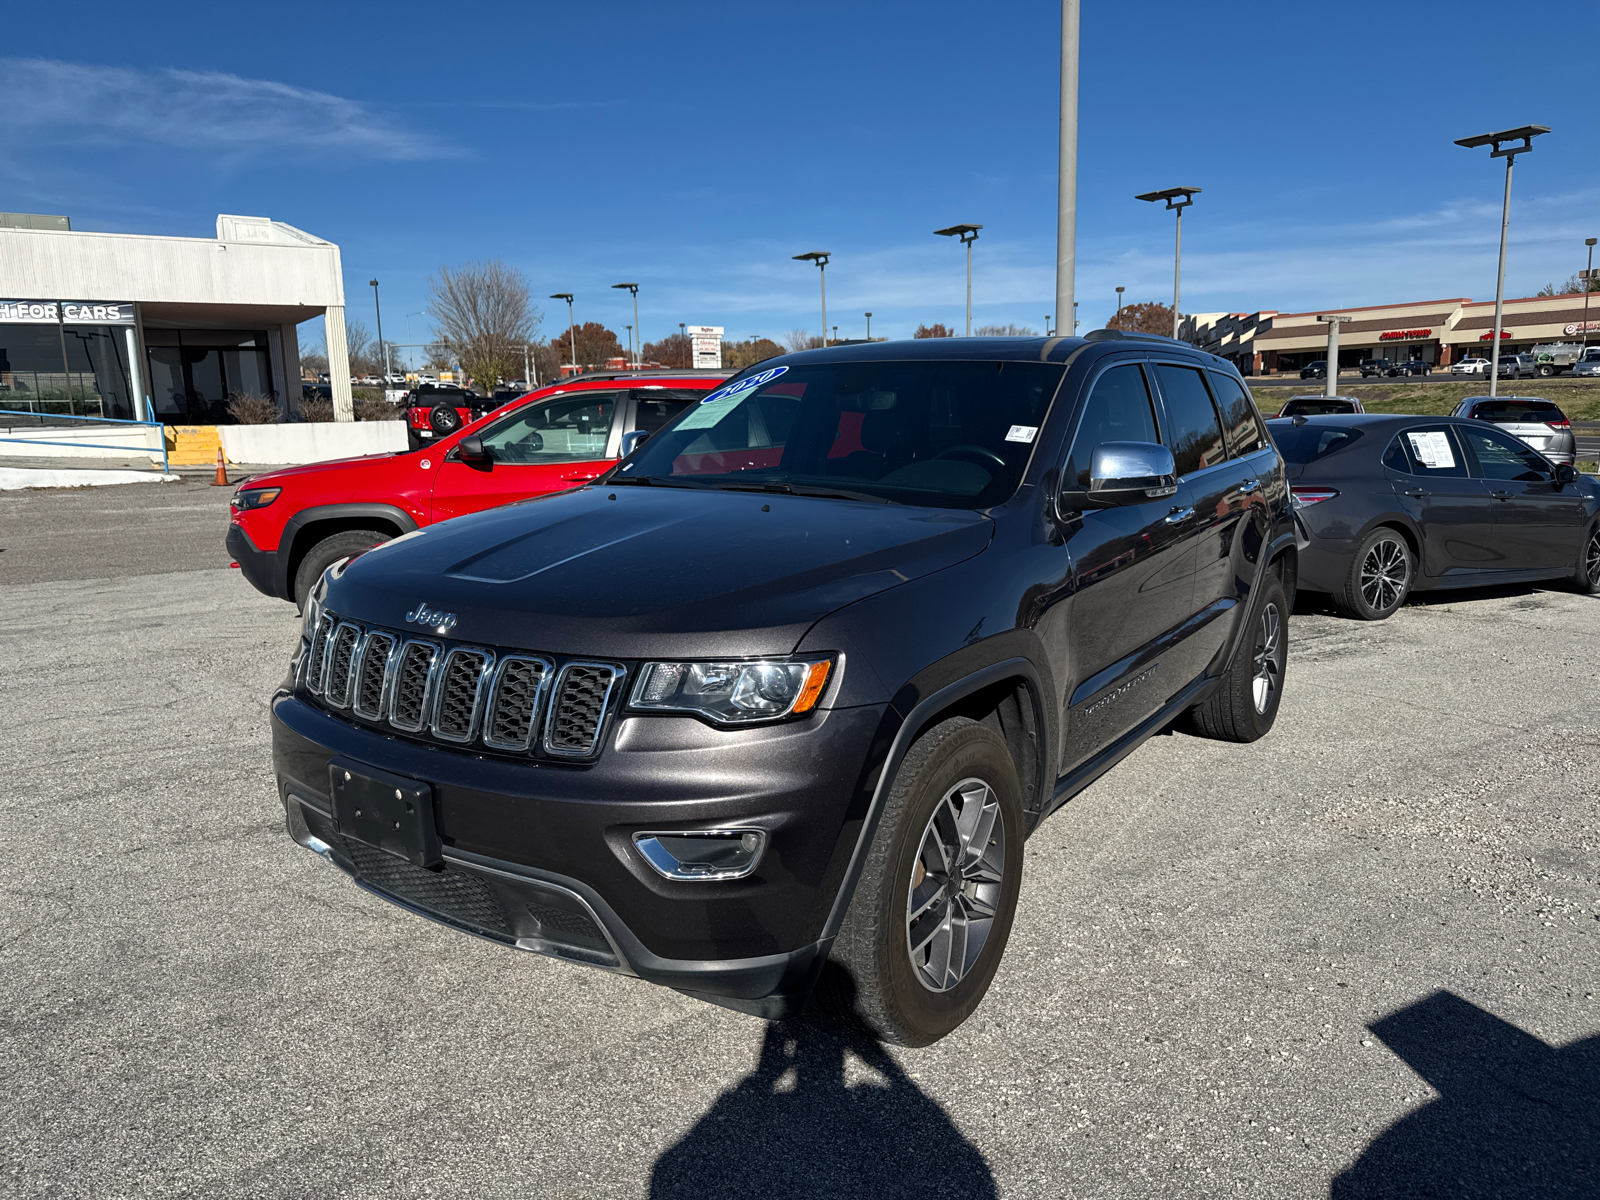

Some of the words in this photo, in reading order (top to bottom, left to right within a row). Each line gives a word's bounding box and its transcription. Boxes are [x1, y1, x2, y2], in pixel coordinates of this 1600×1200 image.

[17, 304, 58, 319] FOR
[64, 305, 120, 320] CARS
[1381, 331, 1406, 339] CHINA
[1406, 328, 1432, 337] TOWN
[714, 368, 776, 401] 2020
[405, 601, 457, 630] Jeep
